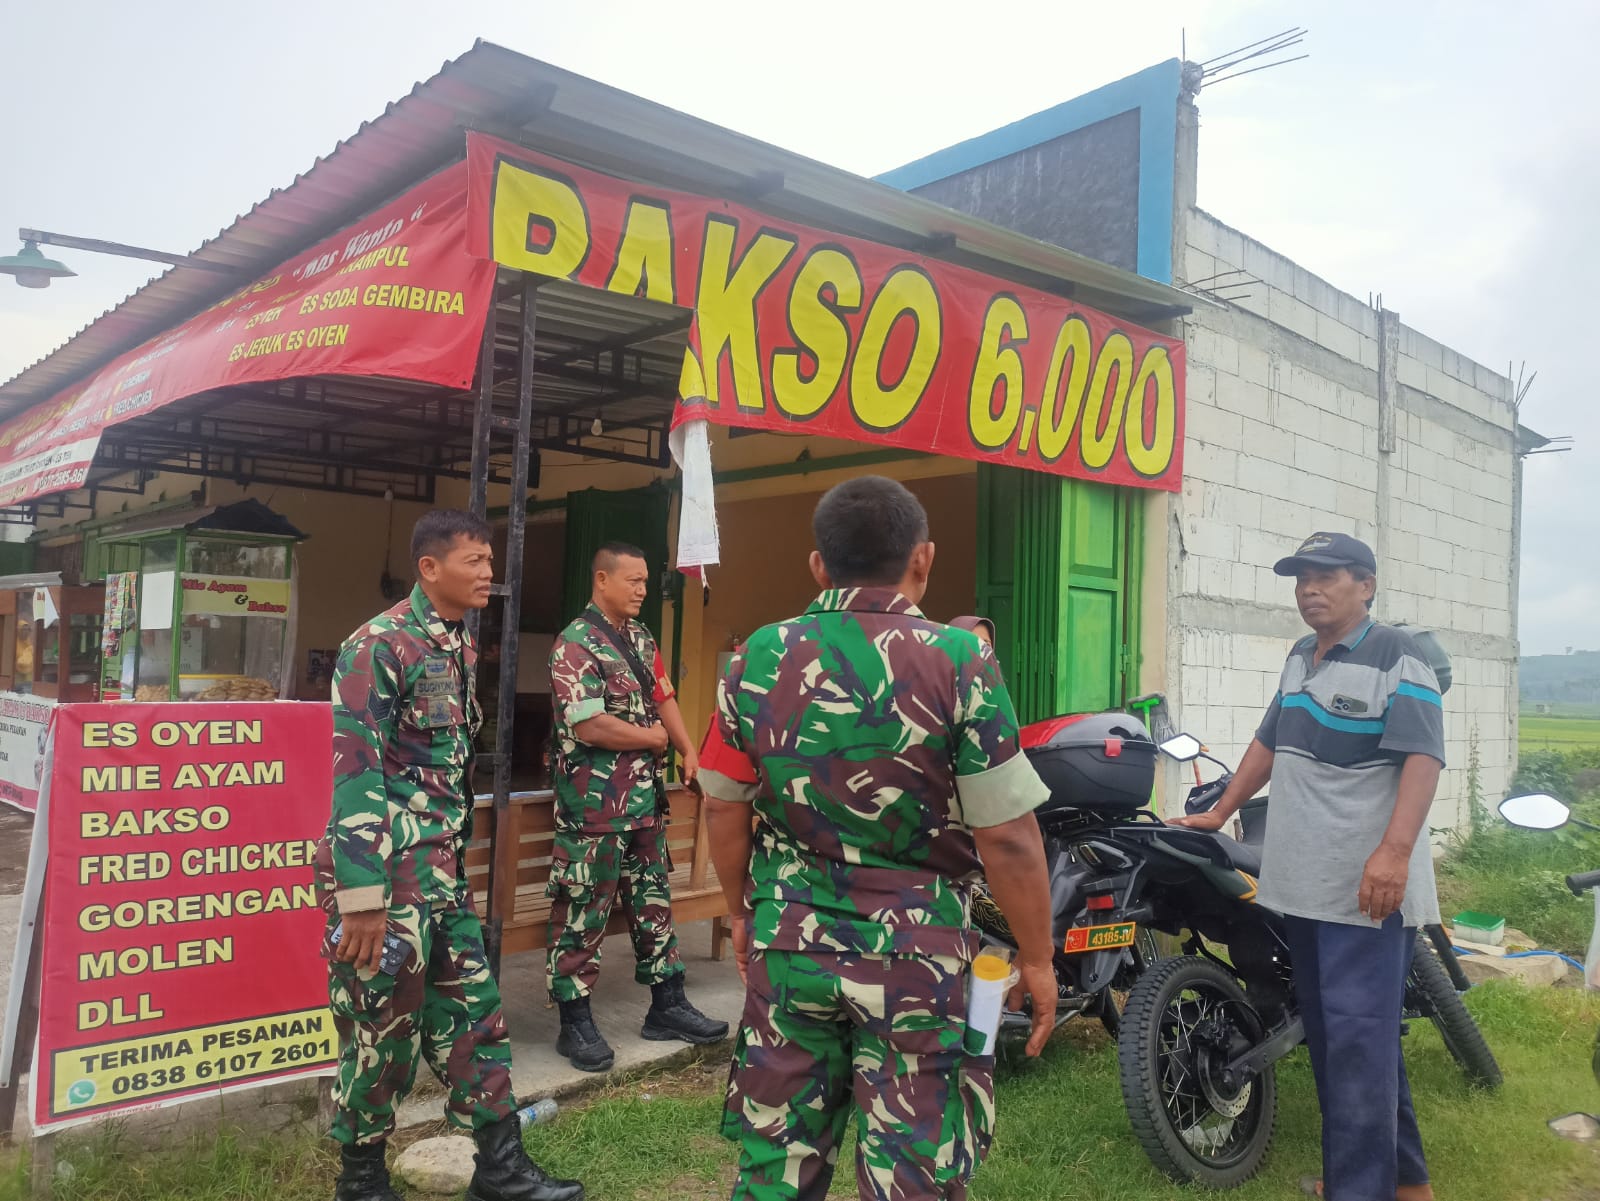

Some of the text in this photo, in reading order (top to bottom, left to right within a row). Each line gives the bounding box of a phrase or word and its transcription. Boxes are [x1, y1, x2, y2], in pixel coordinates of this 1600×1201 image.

[299, 294, 319, 315] ES
[319, 286, 359, 311] SODA
[362, 284, 465, 316] GEMBIRA
[228, 324, 350, 362] ES JERUK ES OYEN
[969, 291, 1177, 479] 6.000
[82, 719, 263, 748] ES OYEN
[80, 759, 286, 794] MIE AYAM
[79, 804, 230, 840] BAKSO
[78, 850, 171, 886] FRED
[78, 883, 318, 933] GORENGAN
[77, 936, 235, 983] MOLEN
[77, 993, 164, 1032] DLL
[79, 1016, 324, 1075] TERIMA PESANAN
[111, 1038, 332, 1097] 0838 6107 2601
